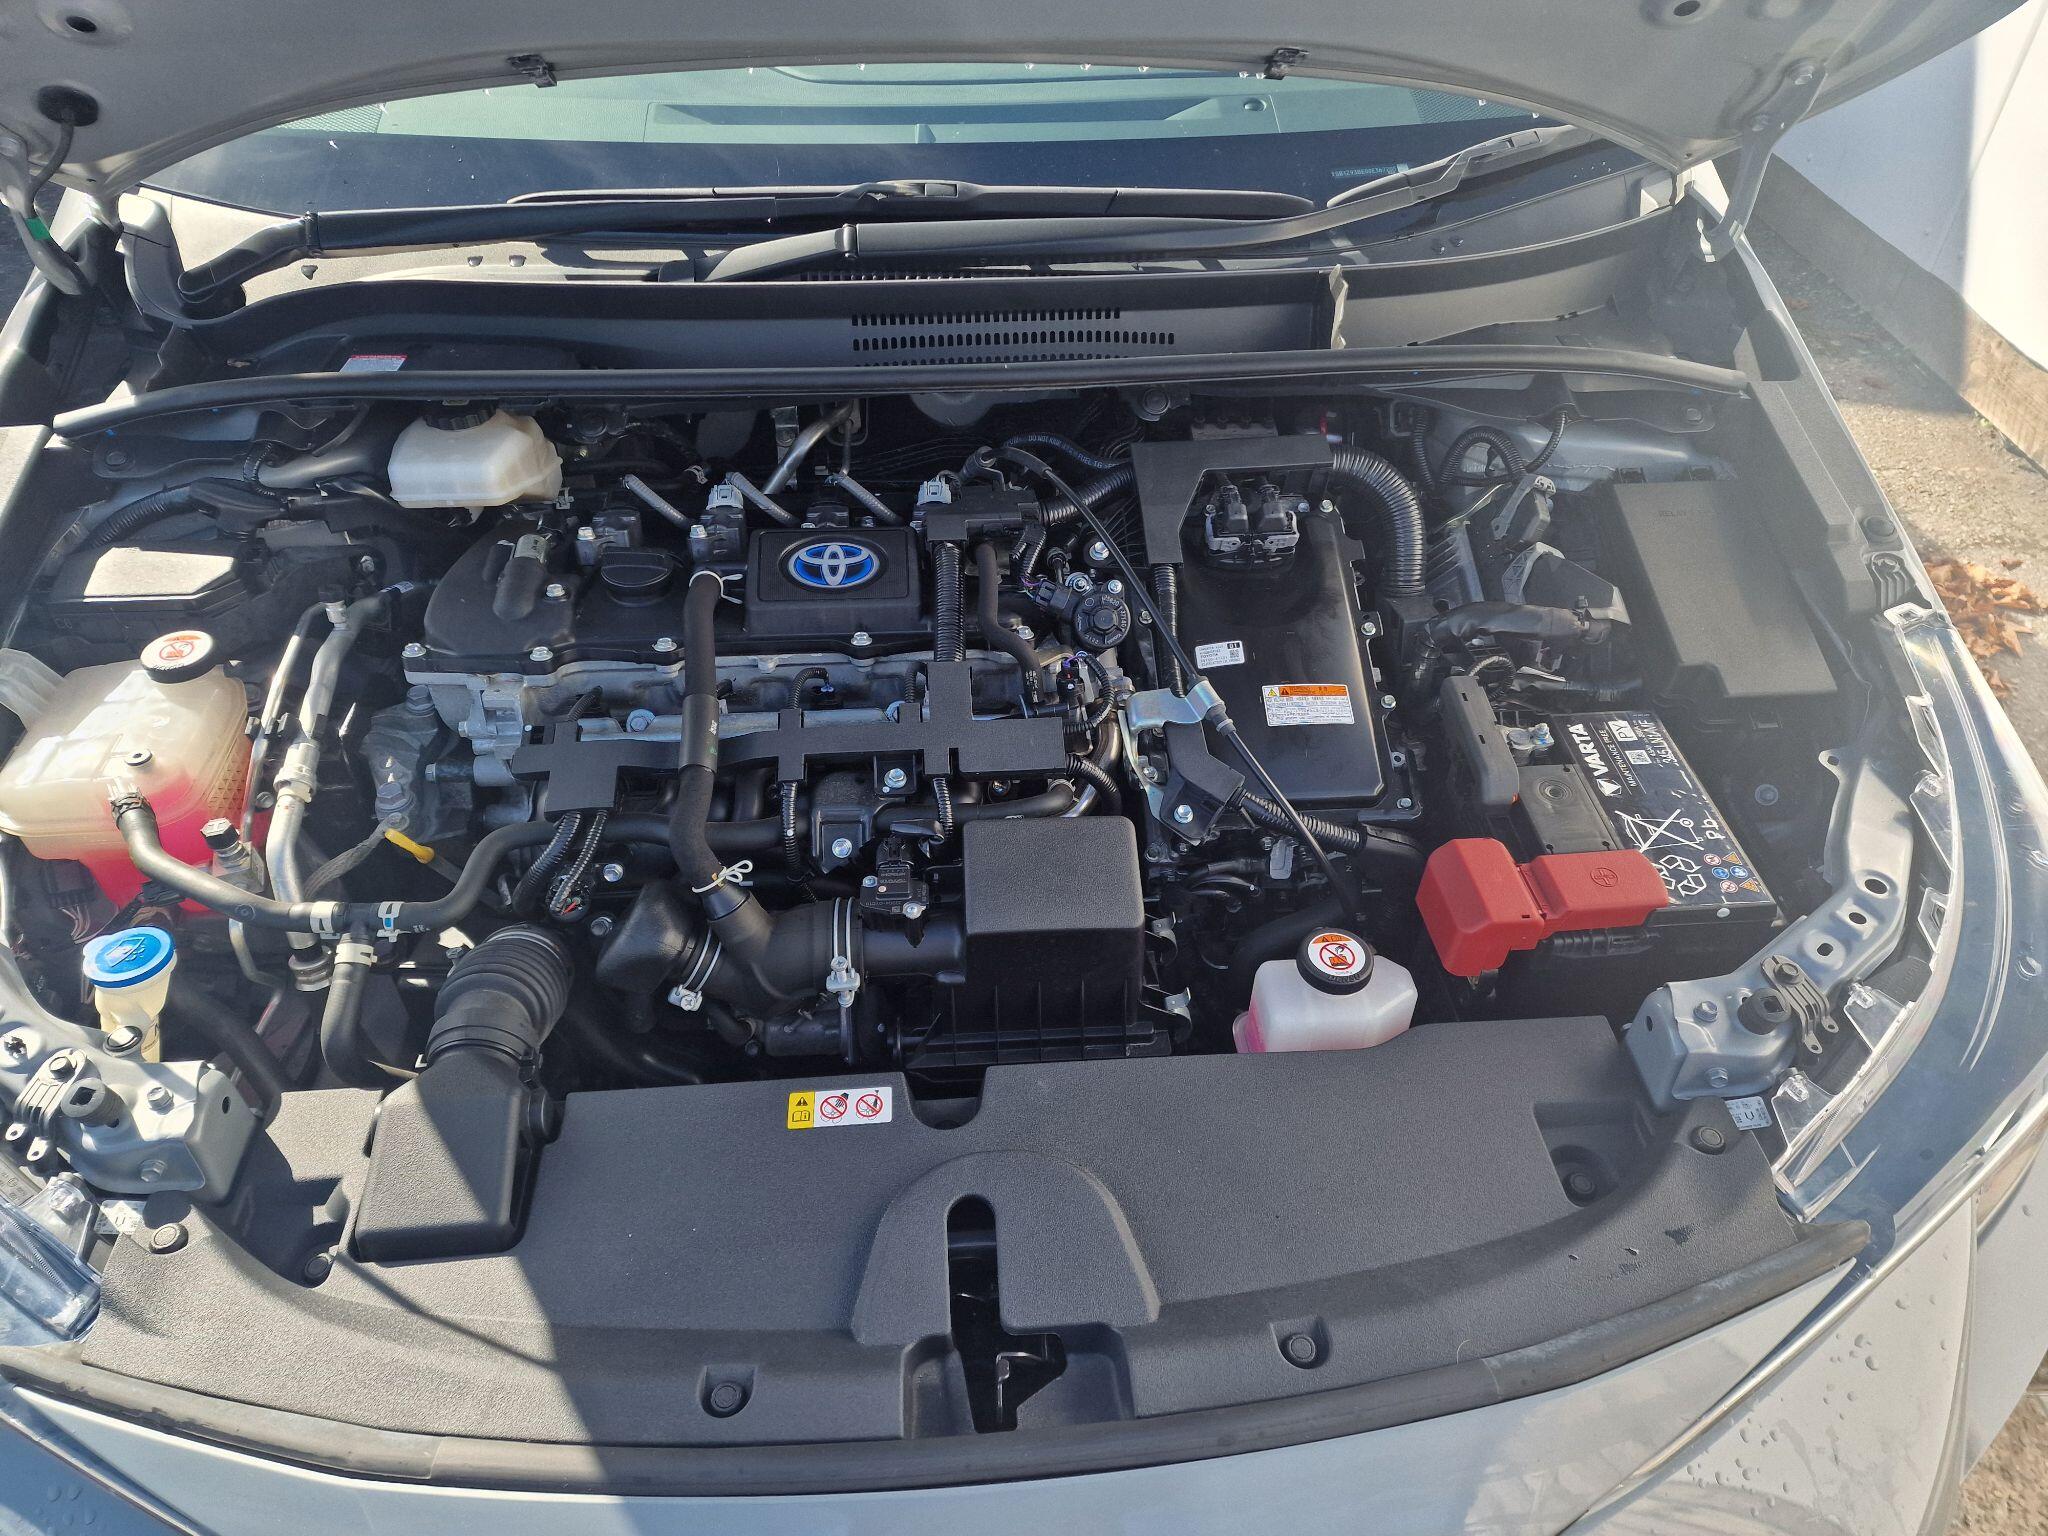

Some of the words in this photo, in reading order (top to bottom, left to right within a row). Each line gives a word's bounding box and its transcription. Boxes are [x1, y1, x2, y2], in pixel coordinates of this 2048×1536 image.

[1599, 729, 1613, 744] FREE
[1613, 721, 1635, 740] PY
[1568, 723, 1609, 777] VARTA
[1607, 743, 1638, 787] MAINTENANCE
[1701, 817, 1727, 840] Pb
